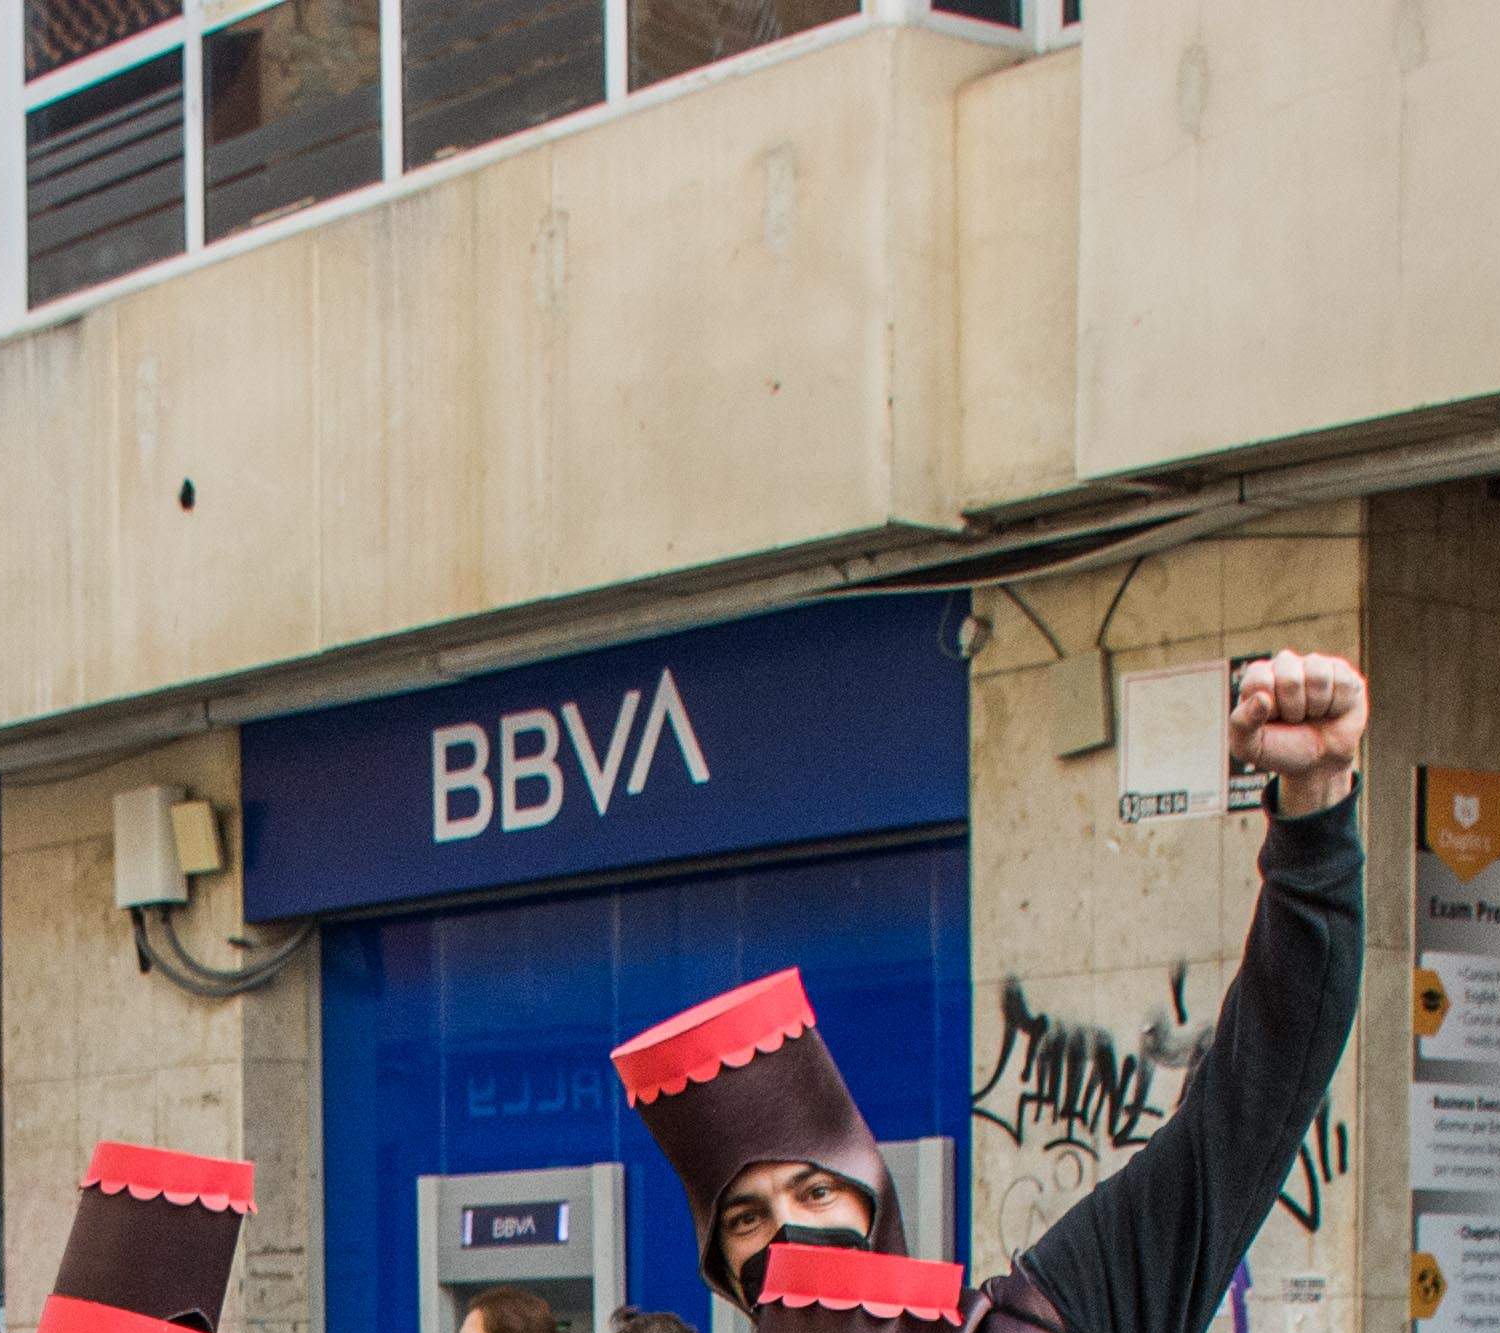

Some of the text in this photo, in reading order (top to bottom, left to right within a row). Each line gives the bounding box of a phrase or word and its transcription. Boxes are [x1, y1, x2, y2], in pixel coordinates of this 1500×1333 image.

[431, 667, 710, 845] BBVA
[1429, 895, 1472, 921] Exam
[1433, 1096, 1474, 1110] Business
[491, 1215, 536, 1239] BBVA
